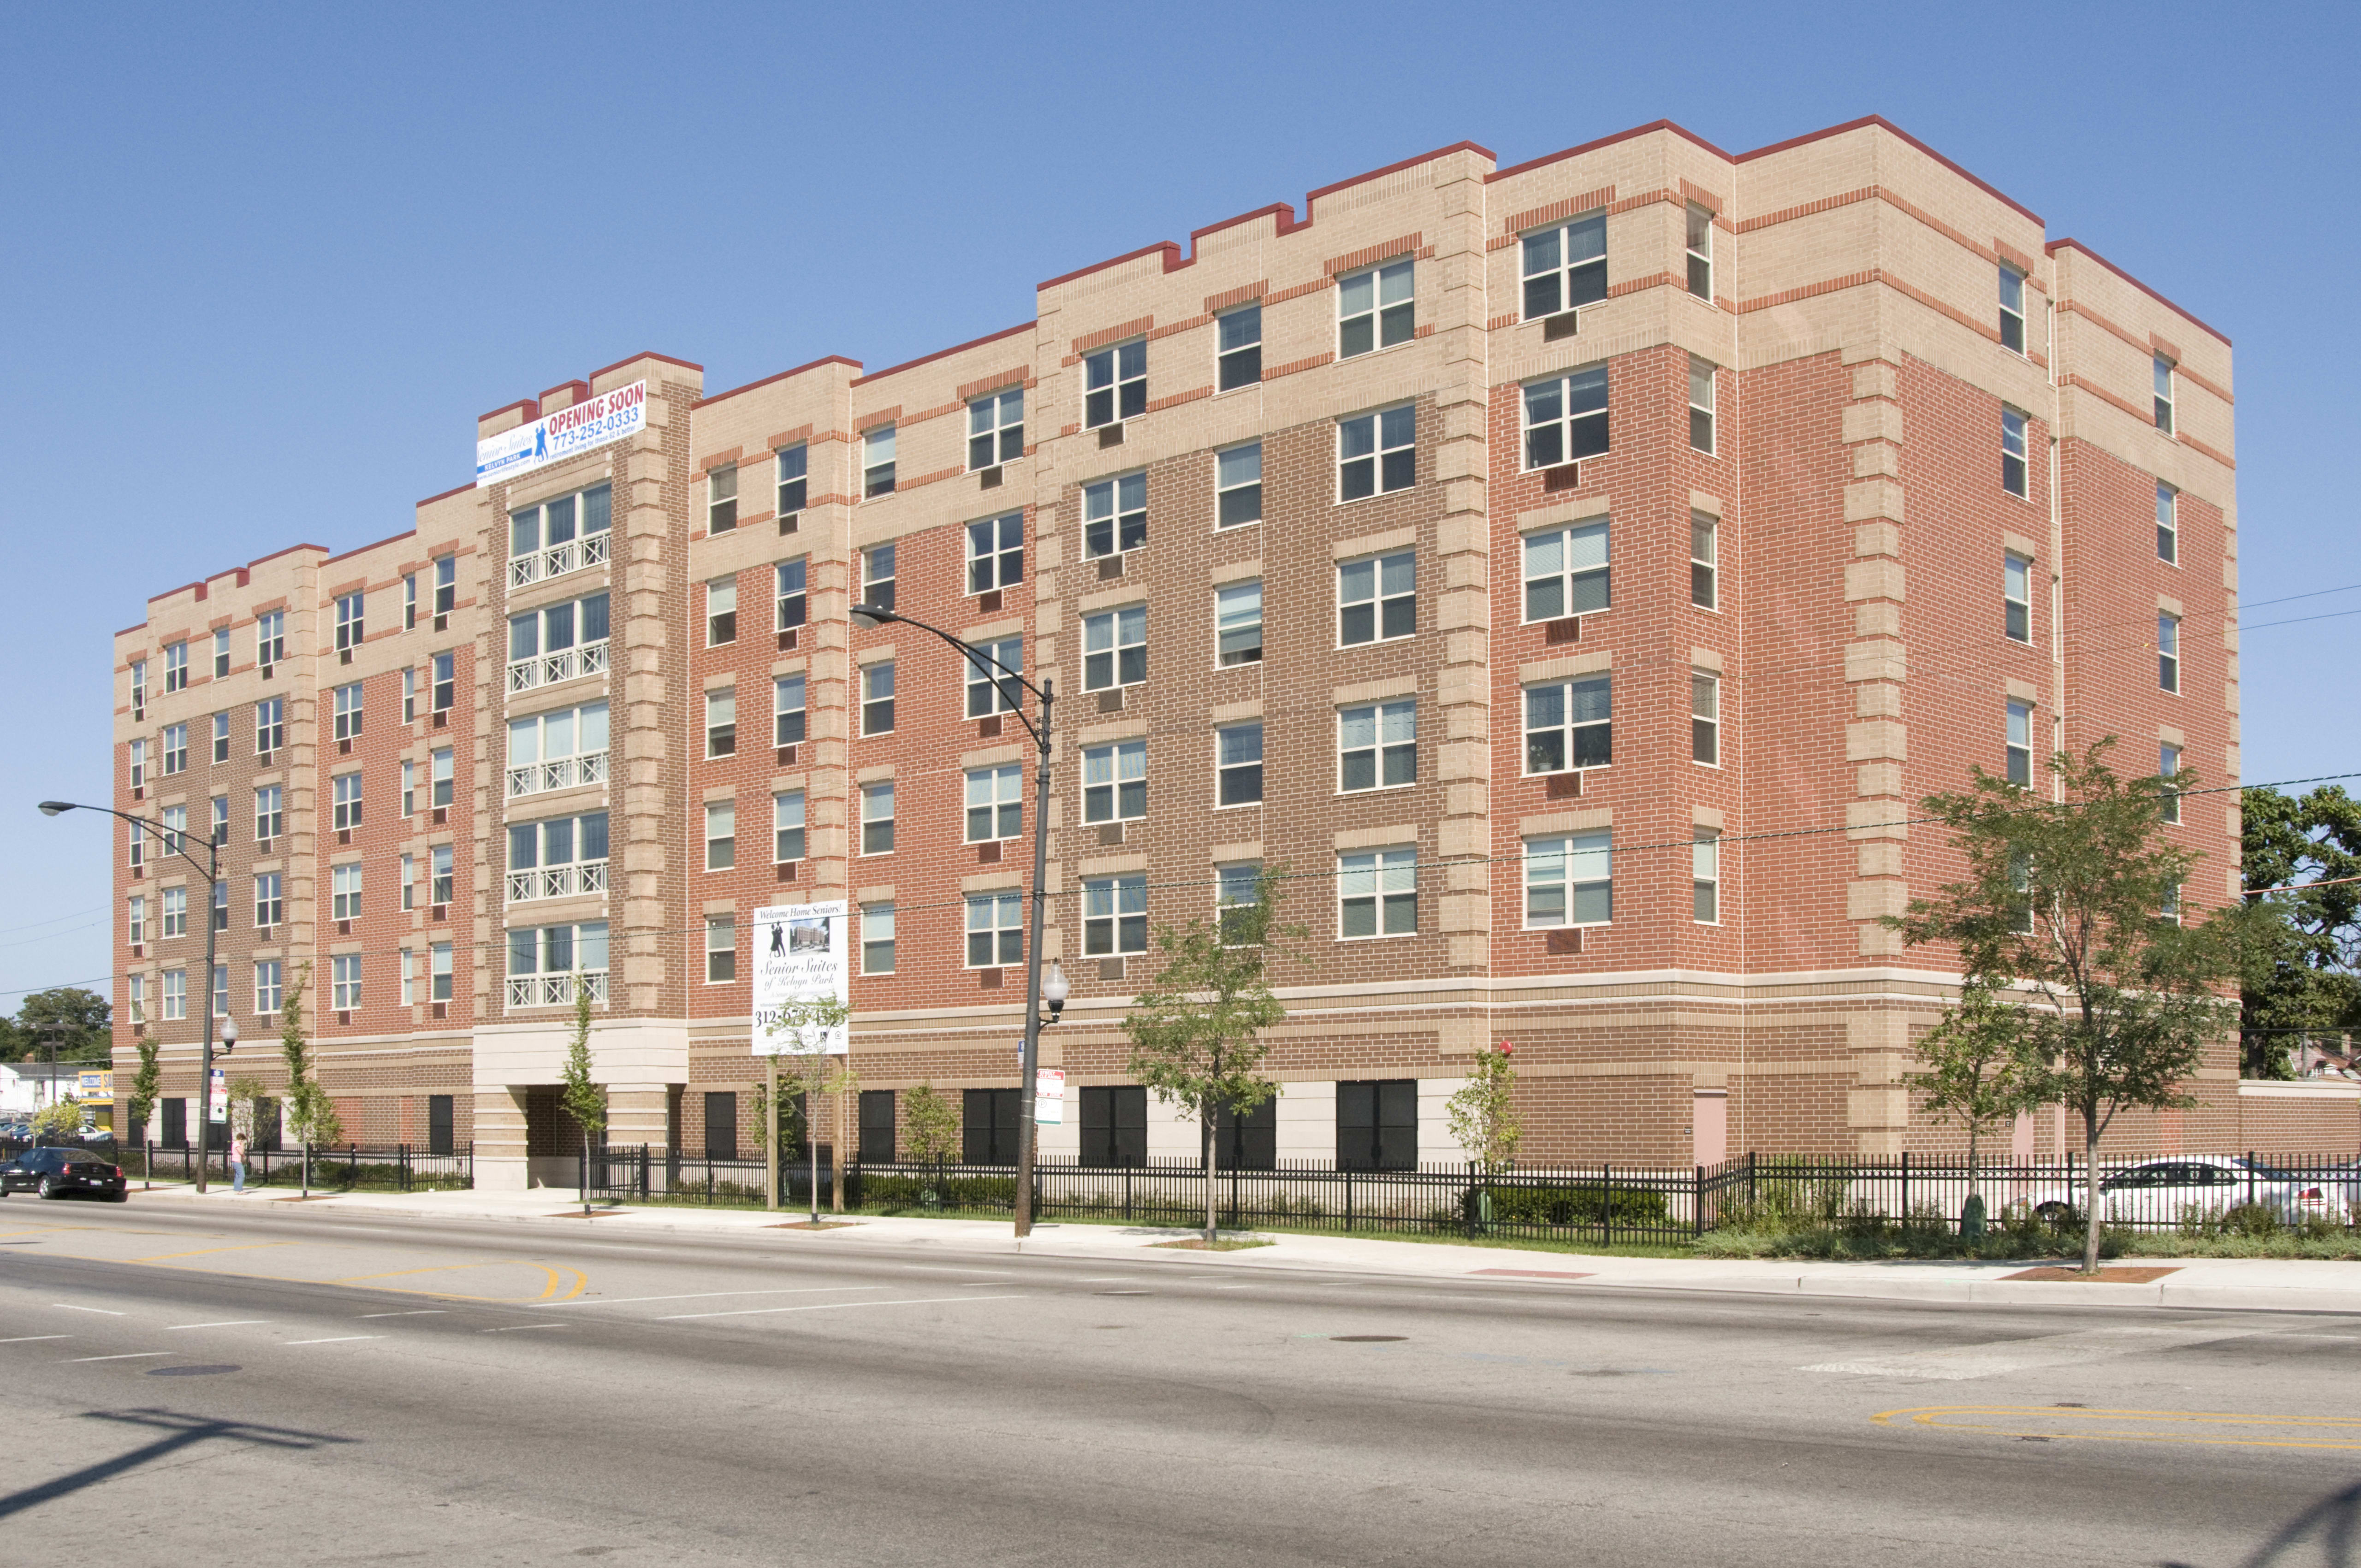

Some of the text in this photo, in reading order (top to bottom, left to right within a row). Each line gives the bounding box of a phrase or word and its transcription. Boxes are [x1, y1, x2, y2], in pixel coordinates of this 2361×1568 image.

[549, 383, 644, 436] OPENING SOON
[553, 407, 639, 450] 773-252-0333
[504, 434, 532, 452] Suites
[550, 447, 573, 460] retirement
[595, 435, 608, 444] those
[609, 431, 615, 439] 62
[621, 425, 635, 435] better
[485, 453, 521, 471] KELVYN PARK
[760, 904, 842, 919] Welcome Home Seniors!
[760, 957, 838, 976] Senior Suites
[764, 973, 834, 991] of Kelvyn Park
[82, 1077, 101, 1086] WELCOME
